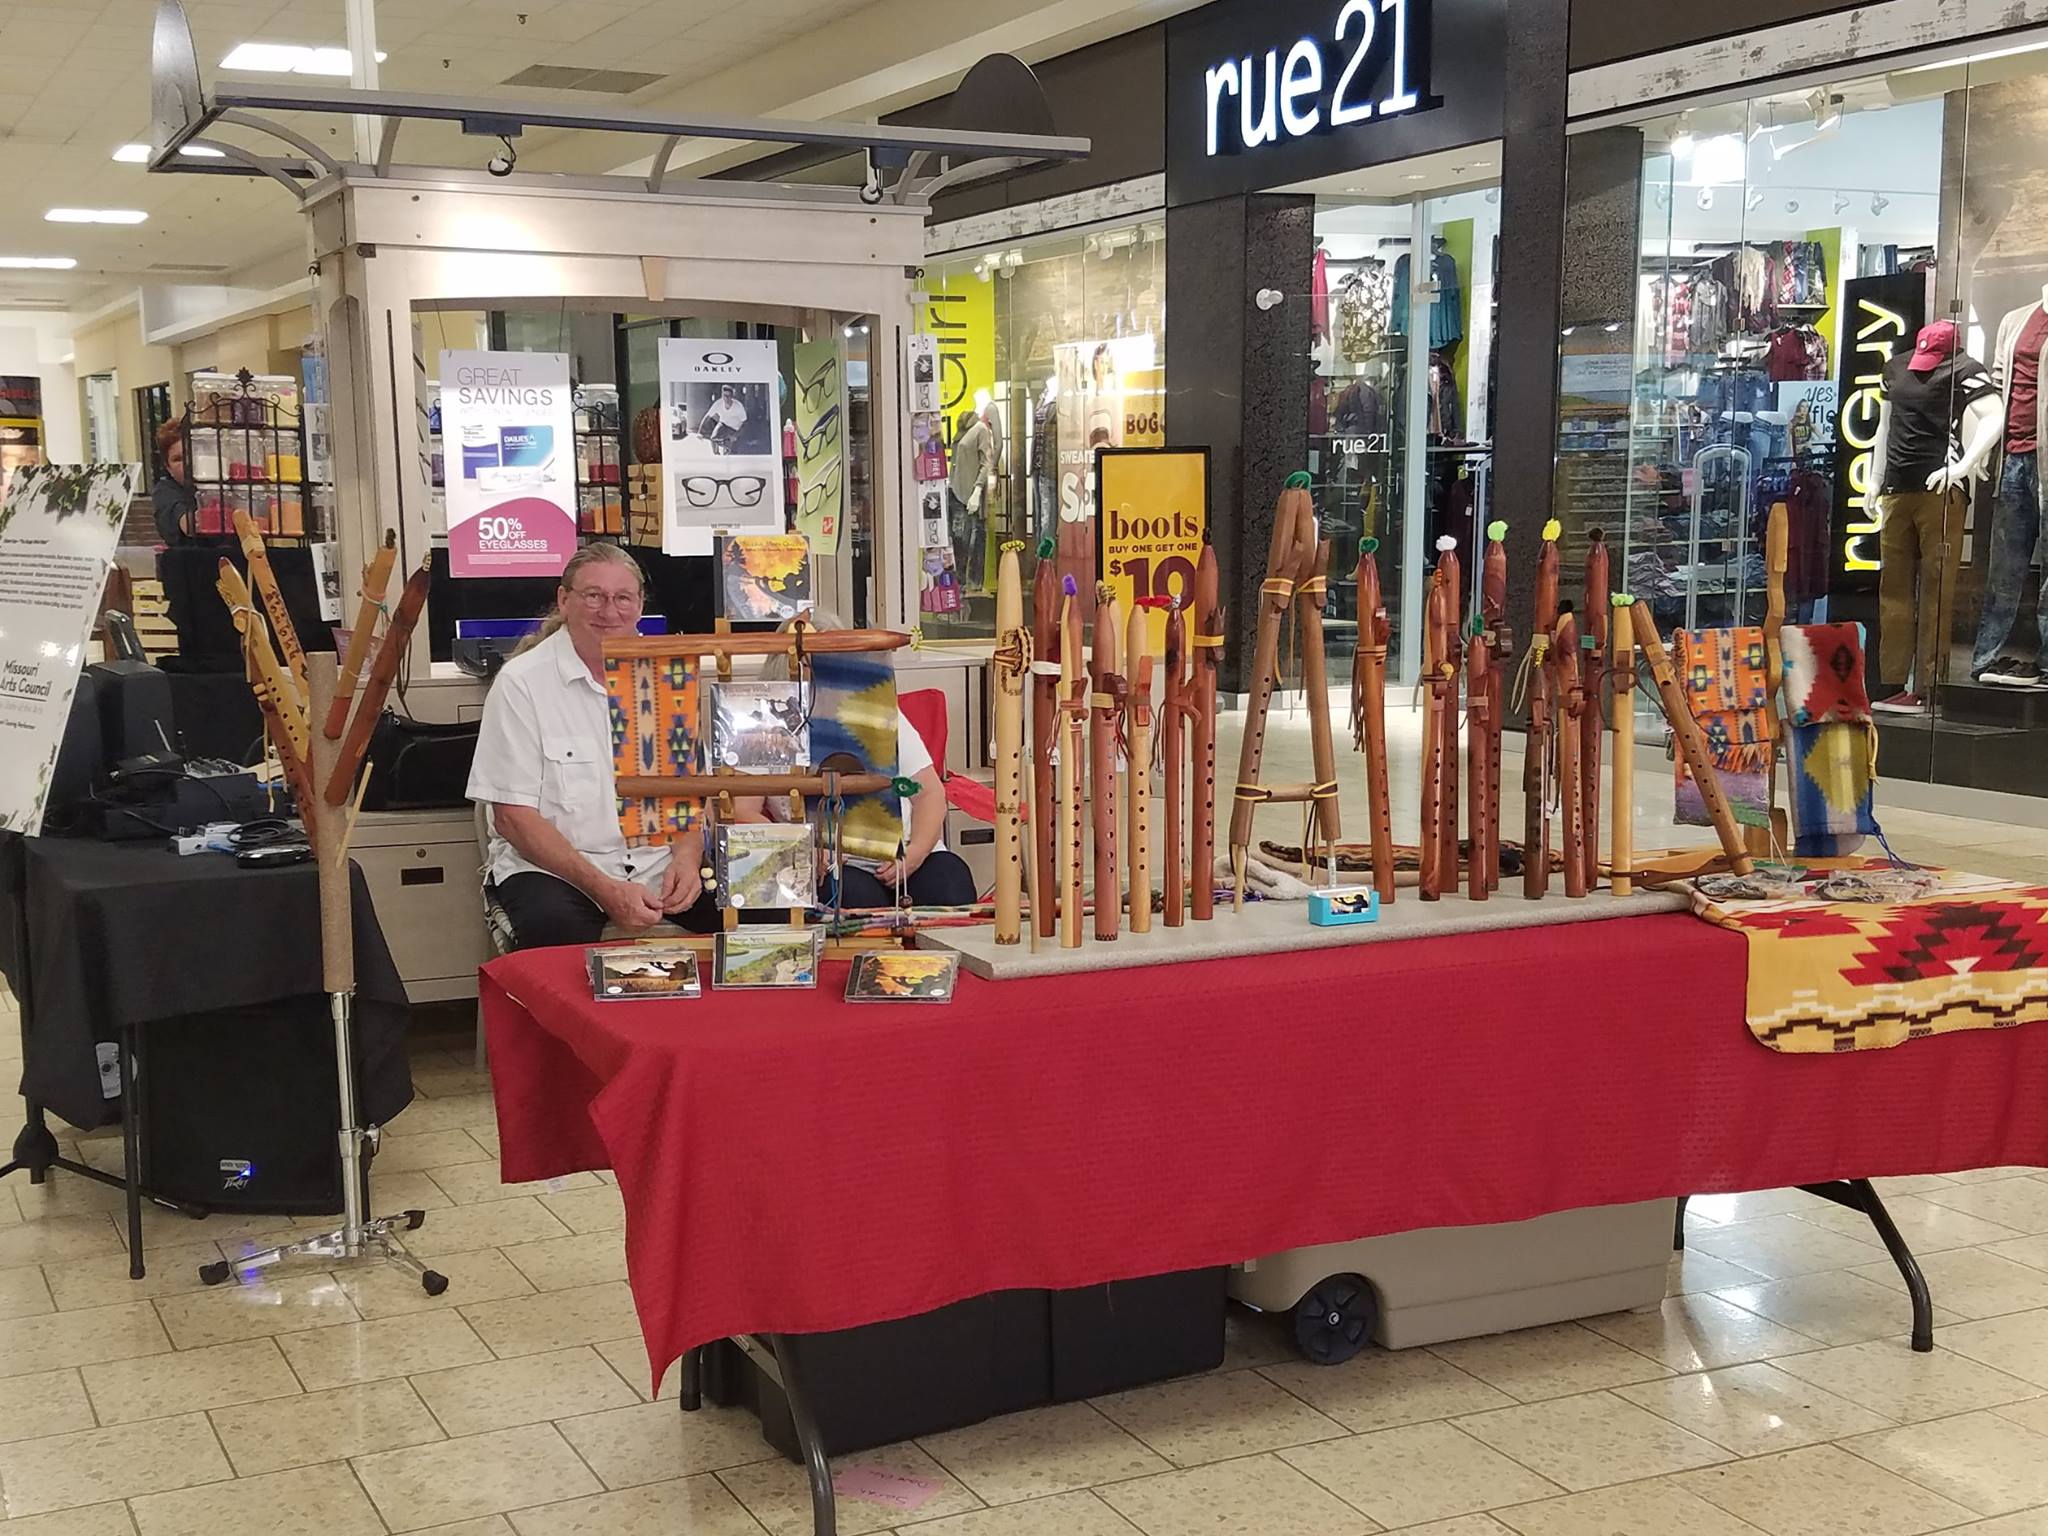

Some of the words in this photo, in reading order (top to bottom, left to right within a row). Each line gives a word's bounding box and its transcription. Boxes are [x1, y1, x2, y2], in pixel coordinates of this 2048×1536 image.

[1205, 0, 1417, 156] rue21
[457, 367, 521, 386] GREAT
[459, 387, 553, 406] SAVINGS
[1332, 433, 1389, 454] rue21
[1844, 299, 1906, 572] rueGuy
[1109, 510, 1199, 540] boots
[479, 540, 547, 549] EYEGLASSES
[508, 531, 526, 539] OFF
[1109, 546, 1128, 554] BUY
[1132, 545, 1152, 553] ONE
[1155, 544, 1174, 552] GET
[1177, 543, 1197, 551] ONE
[1110, 556, 1196, 614] $10
[3, 660, 40, 677] Missouri
[0, 677, 17, 692] Arts
[18, 678, 53, 697] Council
